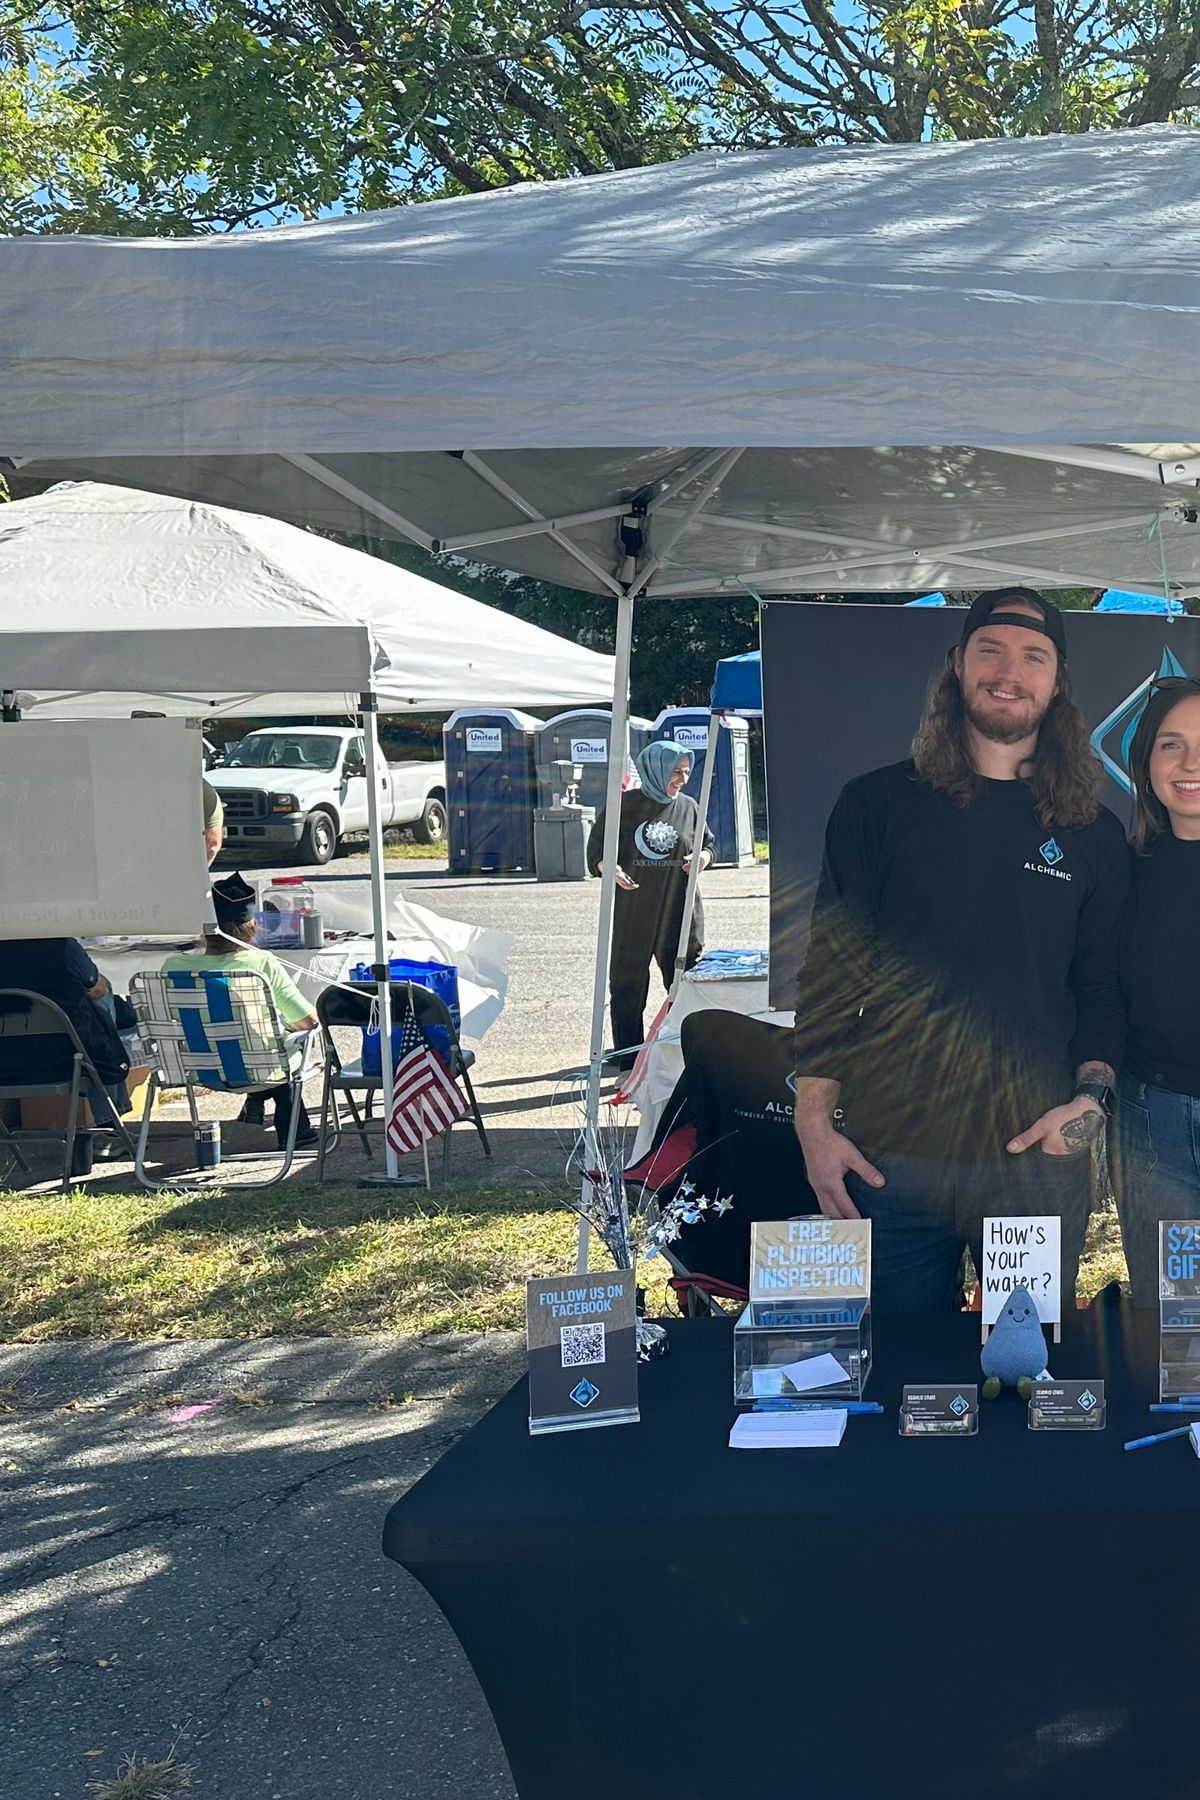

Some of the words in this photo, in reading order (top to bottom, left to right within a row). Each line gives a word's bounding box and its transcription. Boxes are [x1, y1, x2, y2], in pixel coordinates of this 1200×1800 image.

[470, 733, 500, 741] United
[677, 733, 707, 741] United
[1023, 861, 1073, 882] ALCHEMIC
[788, 1221, 833, 1243] FREE
[991, 1221, 1046, 1245] How's
[767, 1243, 857, 1266] PLUMBING
[758, 1266, 865, 1289] INSPECTION
[539, 1288, 587, 1306] FOLLOW
[589, 1287, 605, 1300] US
[606, 1284, 624, 1299] ON
[551, 1299, 612, 1318] FACEBOOK
